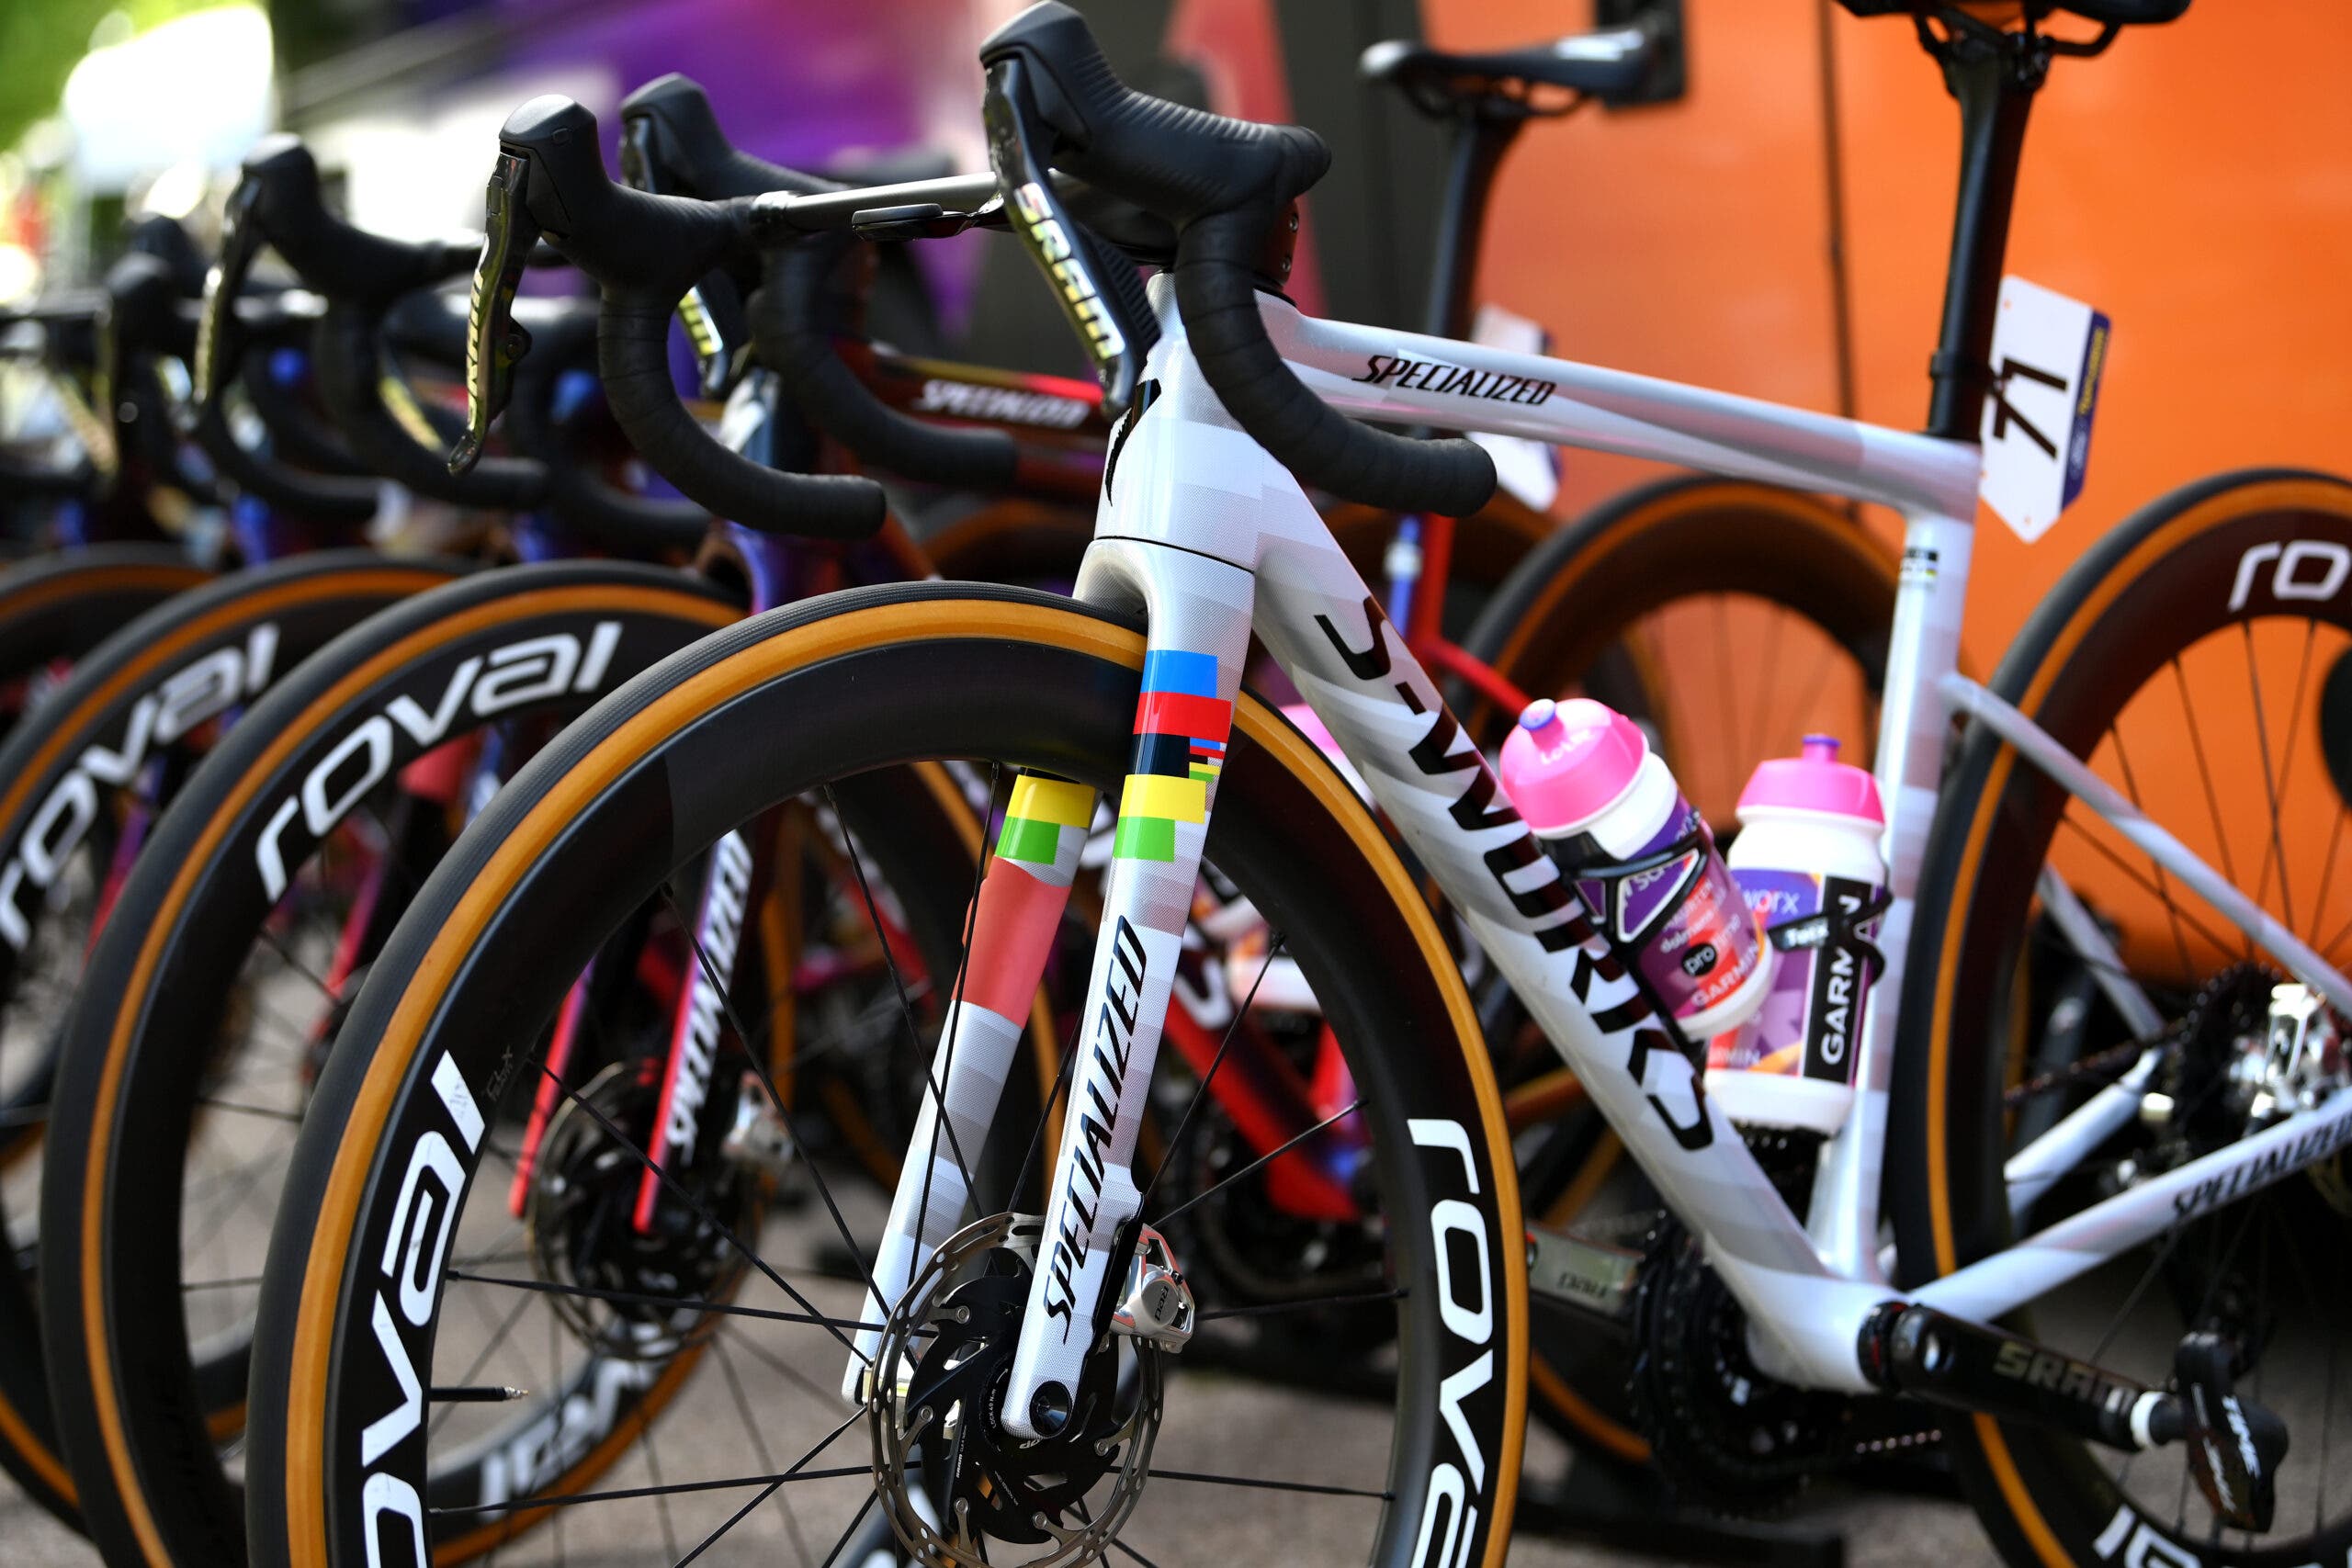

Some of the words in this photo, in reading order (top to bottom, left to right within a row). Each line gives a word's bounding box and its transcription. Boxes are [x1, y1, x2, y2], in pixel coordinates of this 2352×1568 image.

[1013, 183, 1126, 359] SRAM
[1352, 354, 1557, 405] SPECIALIZED
[1992, 356, 2068, 459] 71
[0, 623, 279, 952] roval
[255, 621, 624, 904] roval
[1314, 595, 1713, 1151] S-WORKS
[1044, 915, 1147, 1345] SPECIALIZED
[362, 1049, 486, 1568] oval
[1407, 1119, 1493, 1568] rova
